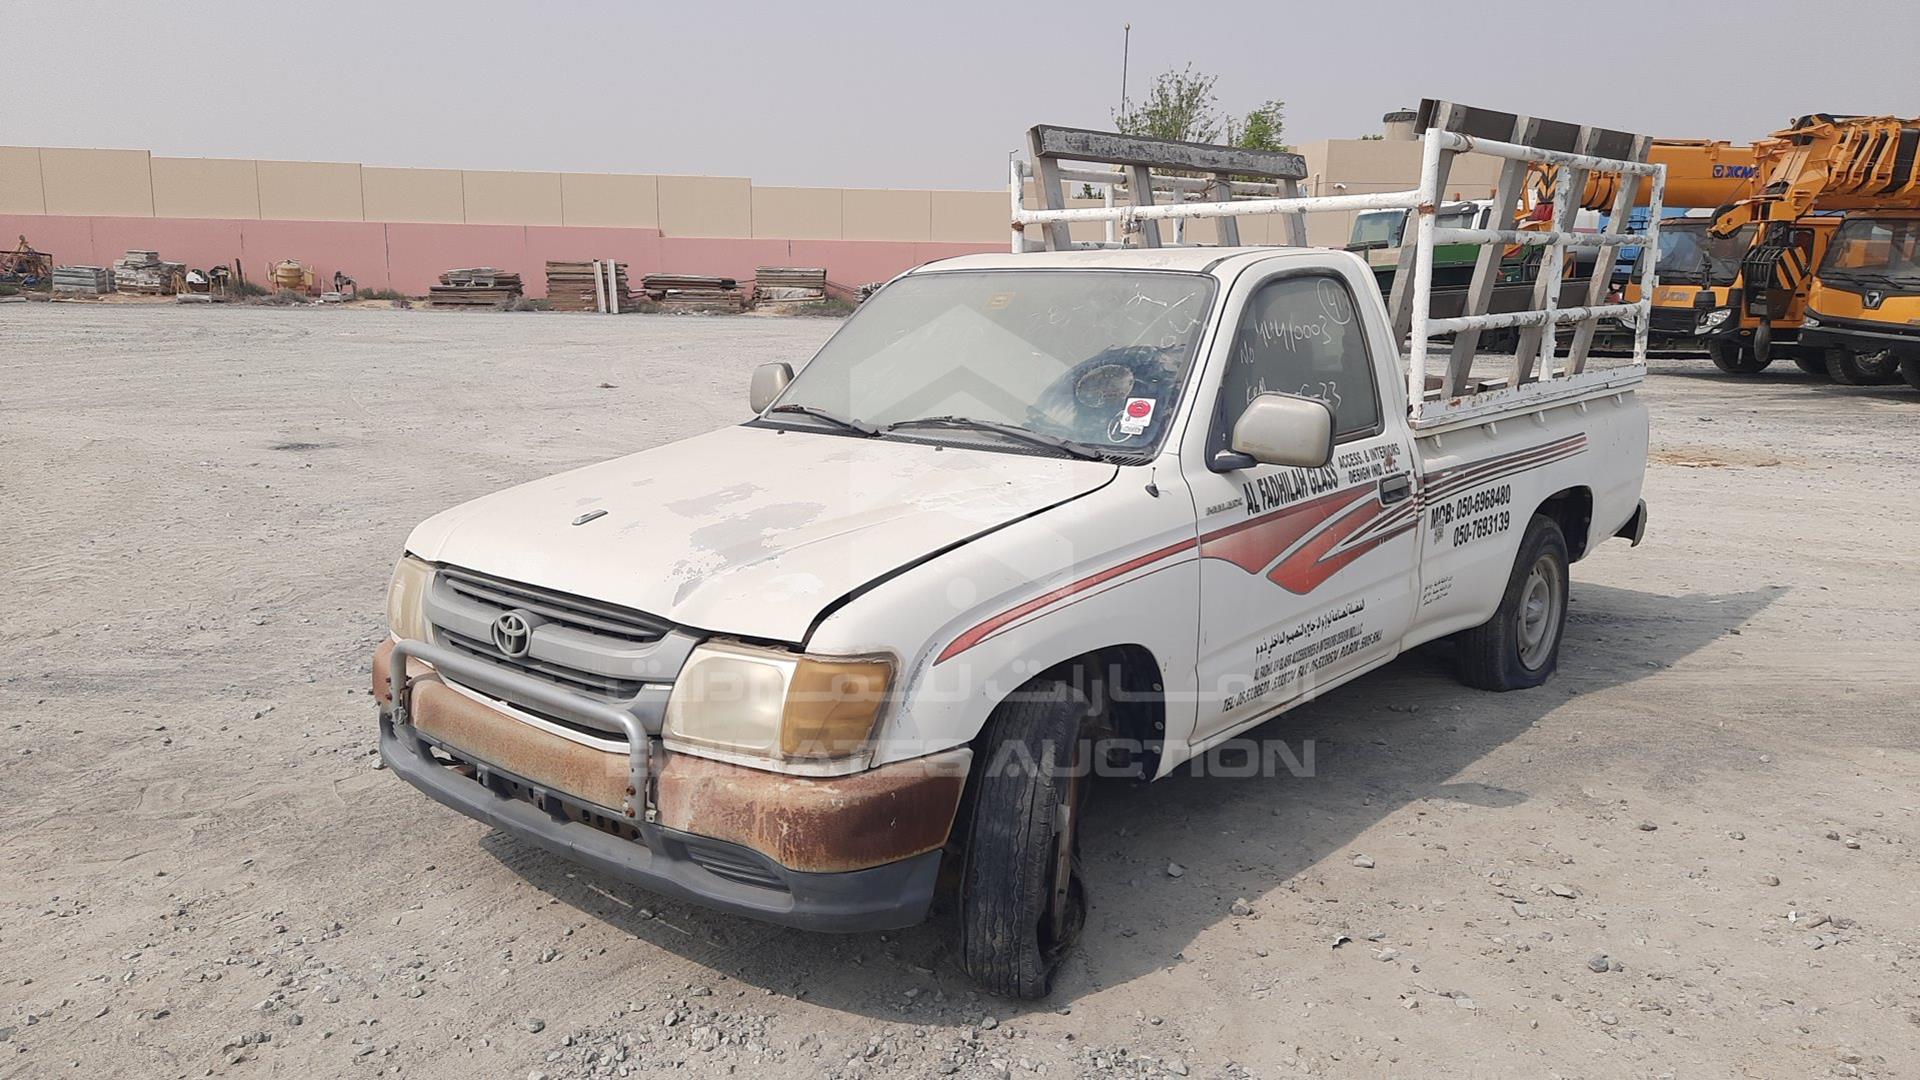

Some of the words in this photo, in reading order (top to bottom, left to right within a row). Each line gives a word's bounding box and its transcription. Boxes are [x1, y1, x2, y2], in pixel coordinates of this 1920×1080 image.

[1243, 482, 1261, 515] AL
[1257, 467, 1309, 511] FADHILAH
[1307, 460, 1339, 495] GLASS
[1348, 465, 1371, 484] DESIGN
[1456, 484, 1511, 520] 050-6968480
[1454, 510, 1510, 547] 050-7693139
